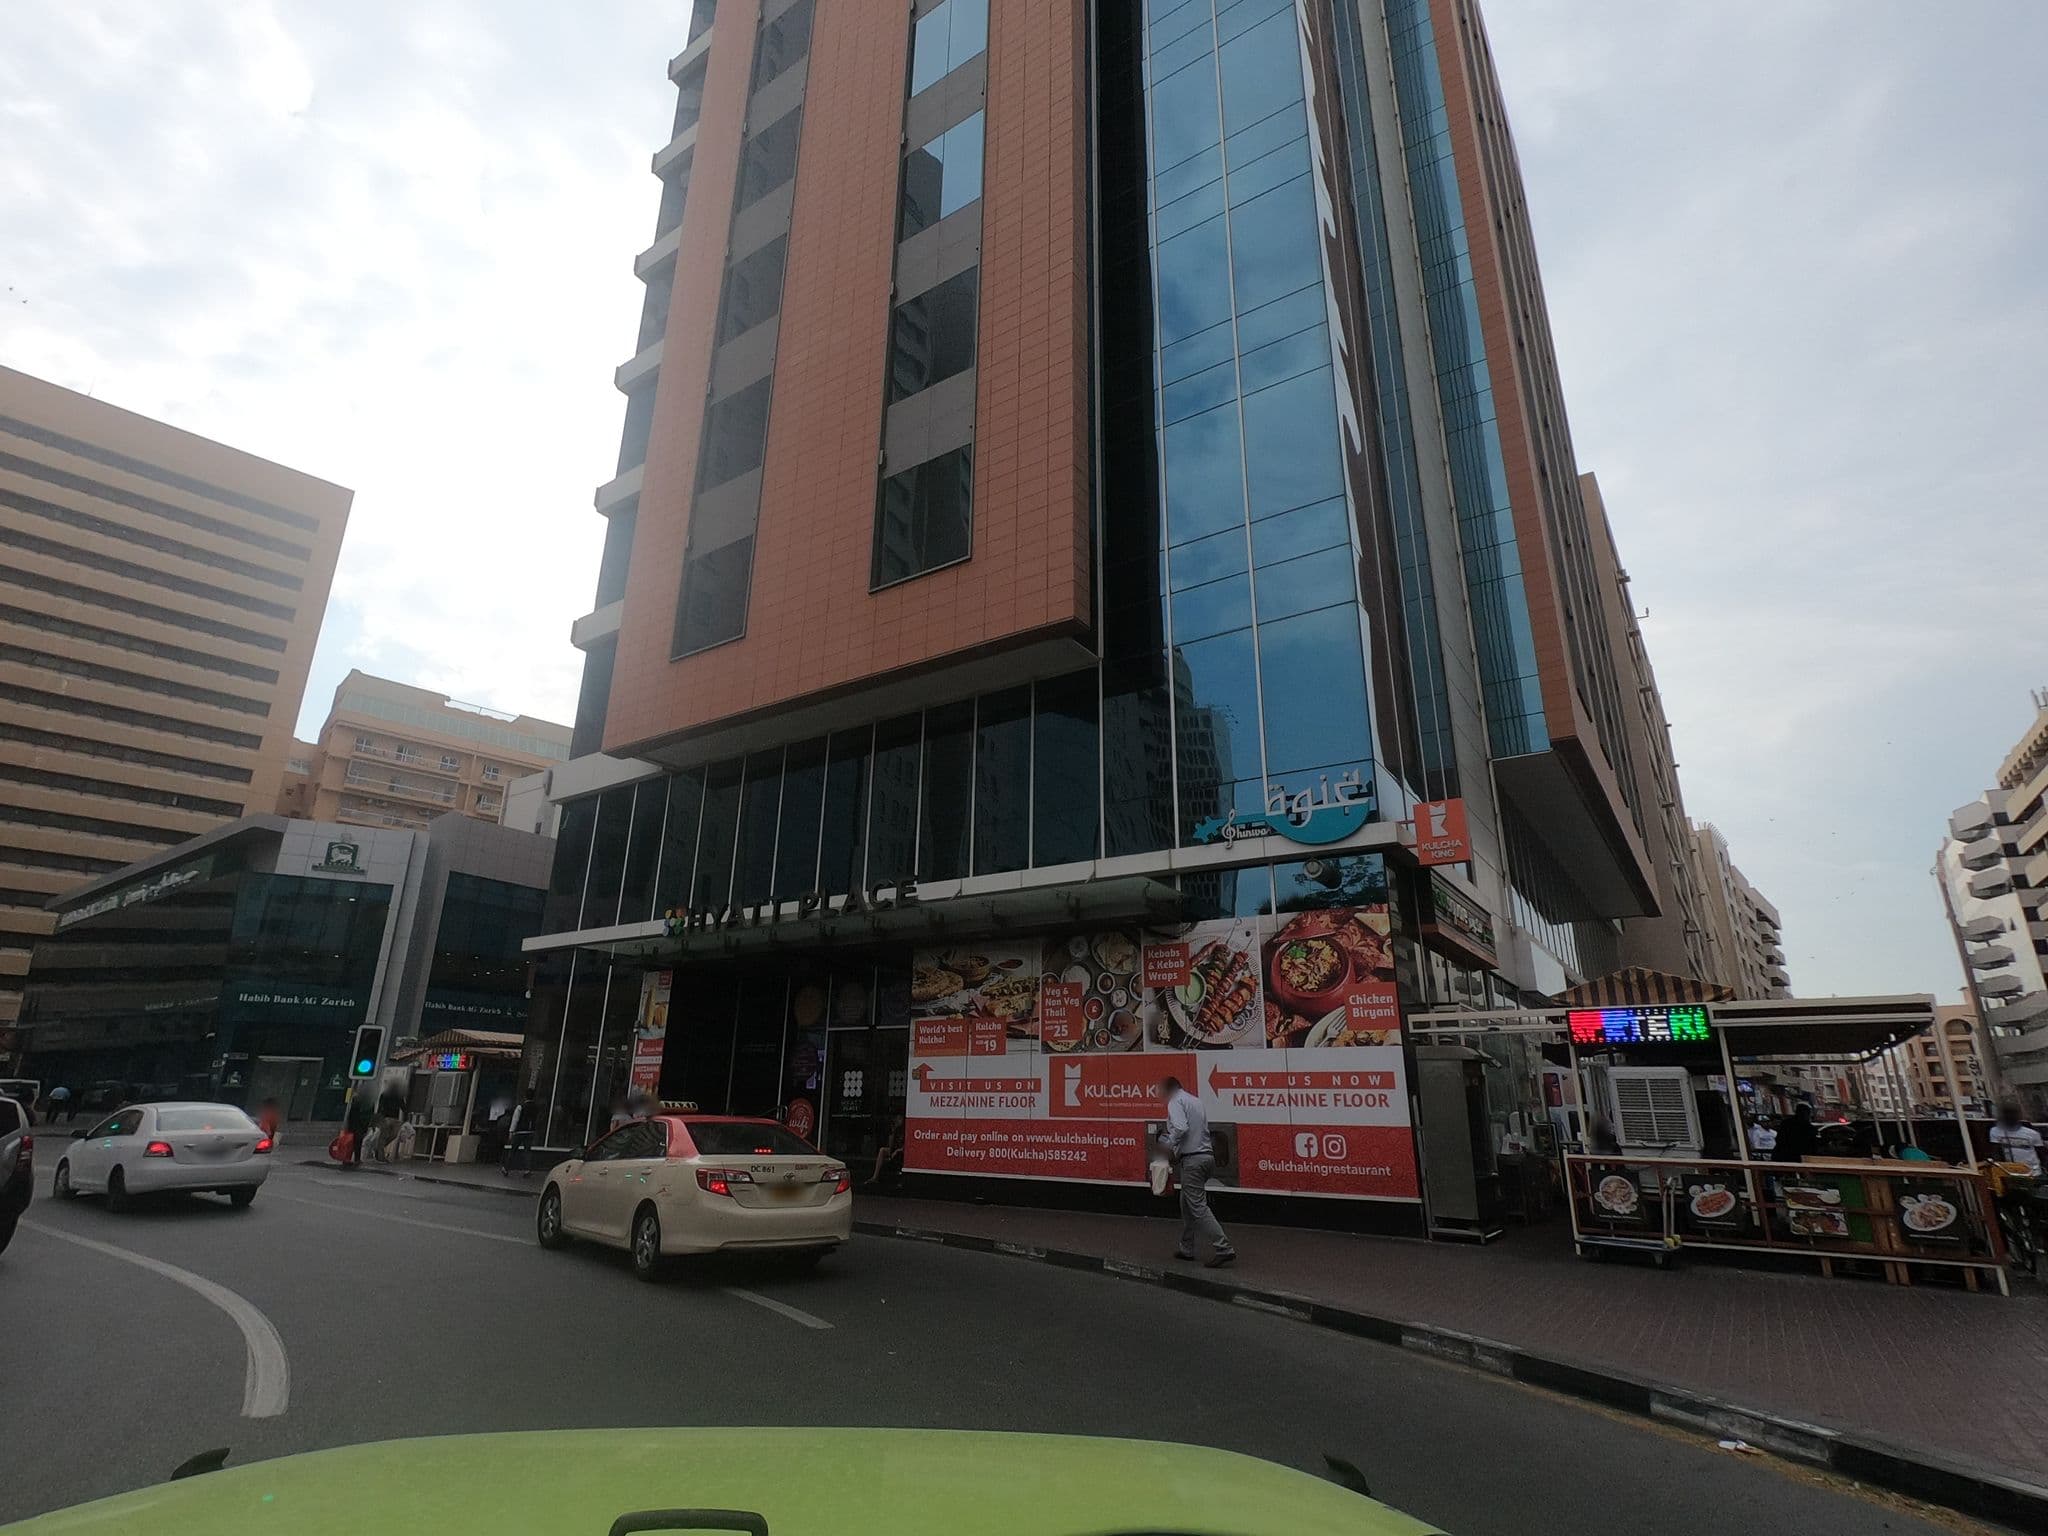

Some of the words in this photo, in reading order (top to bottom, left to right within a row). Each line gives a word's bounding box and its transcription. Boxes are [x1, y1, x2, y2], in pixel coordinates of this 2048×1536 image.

[1421, 839, 1463, 851] KULCHA
[1431, 849, 1456, 860] KING
[688, 899, 782, 930] HYATT
[799, 879, 919, 918] PLACE
[1147, 948, 1180, 959] Kebabs
[1157, 959, 1185, 969] Kebab
[1148, 972, 1178, 982] Wraps
[1045, 987, 1061, 997] Veg
[1063, 987, 1069, 995] &
[239, 993, 271, 1003] Habib
[273, 995, 300, 1004] Bank
[302, 996, 317, 1005] AG
[320, 997, 356, 1007] Zurich
[1045, 998, 1062, 1006] Non
[1063, 997, 1080, 1007] Veg
[1348, 993, 1394, 1005] Chicken
[1045, 1008, 1066, 1017] Thali
[1352, 1005, 1395, 1020] Biryani
[919, 1025, 946, 1034] World's
[947, 1024, 964, 1033] best
[975, 1022, 1002, 1032] Kulcha
[1053, 1025, 1068, 1037] 25
[918, 1035, 946, 1045] Kulcha!
[984, 1040, 997, 1051] 19
[930, 1082, 972, 1090] VISIT
[985, 1082, 1002, 1090] US
[1015, 1081, 1034, 1090] ON
[1230, 1075, 1268, 1086] TRY
[1288, 1075, 1312, 1086] US
[1332, 1075, 1382, 1086] NOW
[1084, 1084, 1143, 1098] KULCHA
[930, 1096, 995, 1107] MEZZANINE
[999, 1096, 1036, 1108] FLOOR
[1233, 1093, 1327, 1107] MEZZANINE
[1334, 1093, 1390, 1108] FLOOR
[914, 1130, 939, 1141] Order
[942, 1130, 959, 1141] and
[960, 1133, 978, 1144] pay
[981, 1131, 1008, 1142] online
[1011, 1134, 1024, 1142] on
[1026, 1132, 1135, 1148] www.kulchaking.com
[946, 1147, 986, 1159] Delivery
[989, 1147, 1087, 1162] 800(Kulcha)585242
[1258, 1159, 1392, 1177] @kulchakingrestaurant
